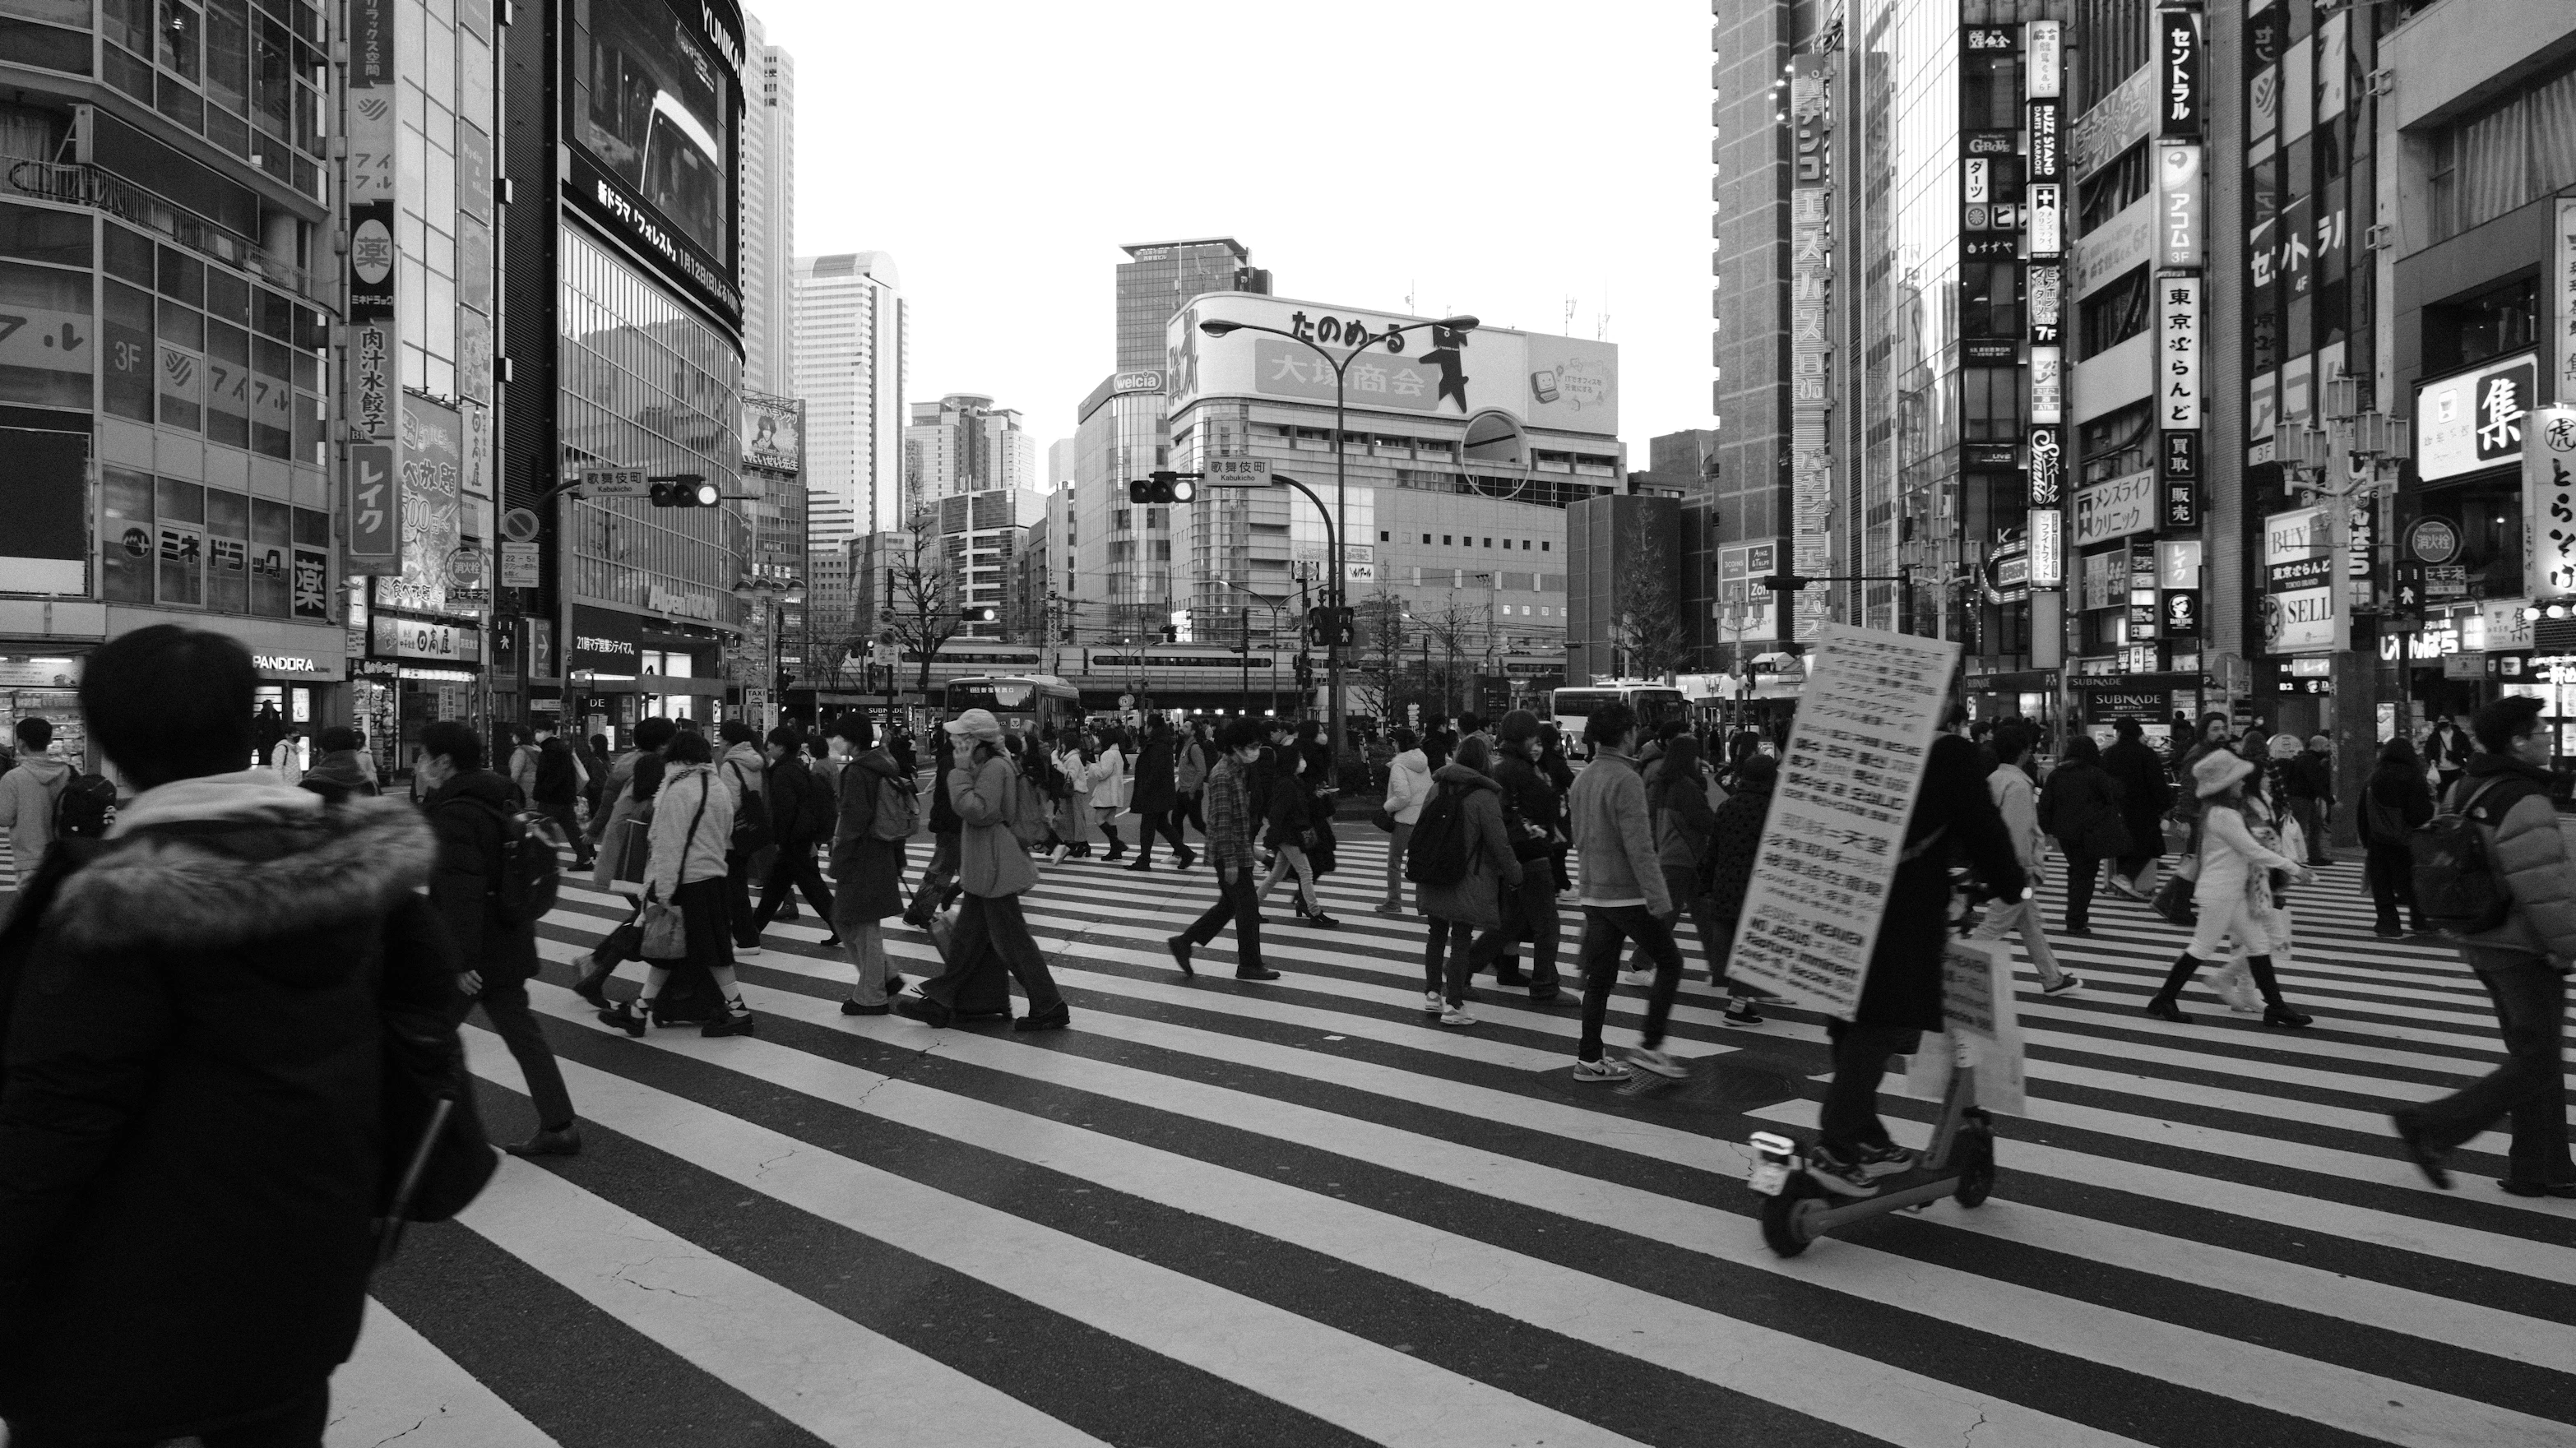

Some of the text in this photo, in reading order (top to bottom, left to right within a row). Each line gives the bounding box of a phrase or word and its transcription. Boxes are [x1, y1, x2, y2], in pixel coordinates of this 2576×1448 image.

[2171, 28, 2190, 120] セントラル
[2033, 106, 2042, 130] DARTS
[2042, 104, 2056, 176] BUZZ STAND
[2034, 140, 2043, 175] KARAOKE
[1970, 160, 1984, 198] ダーツ
[2171, 193, 2190, 248] アコム
[357, 237, 390, 269] 薬
[2171, 251, 2189, 263] 3F
[2295, 275, 2308, 293] 4F
[1292, 311, 1405, 354] たのめーる
[2035, 326, 2057, 341] 7F
[114, 340, 141, 373] 3F
[2168, 288, 2192, 421] 東京ぶらんど
[211, 365, 289, 412] アイフル
[360, 327, 387, 434] 肉汁水餃子
[1116, 371, 1156, 389] welcia
[1564, 375, 1602, 386] ITでオフィスを
[1564, 383, 1593, 393] 元気にする
[2037, 403, 2055, 411] ATM
[2476, 378, 2526, 451] 集
[1211, 461, 1266, 474] 歌舞伎町
[2171, 438, 2189, 472] 買取
[2257, 445, 2273, 462] 3F
[587, 472, 642, 484] 歌舞伎町
[358, 460, 385, 534] レイク
[2093, 476, 2152, 511] メンズライフ
[2171, 487, 2190, 521] 販売
[2092, 505, 2140, 537] クリニック
[160, 530, 281, 580] ミネドラッグ
[2271, 525, 2307, 555] BUY
[2416, 534, 2451, 549] 消火栓
[454, 562, 481, 574] 消火栓
[2172, 544, 2186, 581] レイク
[2425, 567, 2465, 581] セキネ
[295, 557, 325, 610] 薬
[2287, 596, 2332, 625] SELL
[253, 655, 314, 671] PANDORA
[2280, 664, 2293, 673] B1
[2072, 677, 2122, 688] SUBNADE
[2278, 682, 2293, 691] B2
[2096, 695, 2161, 706] SUBNADE
